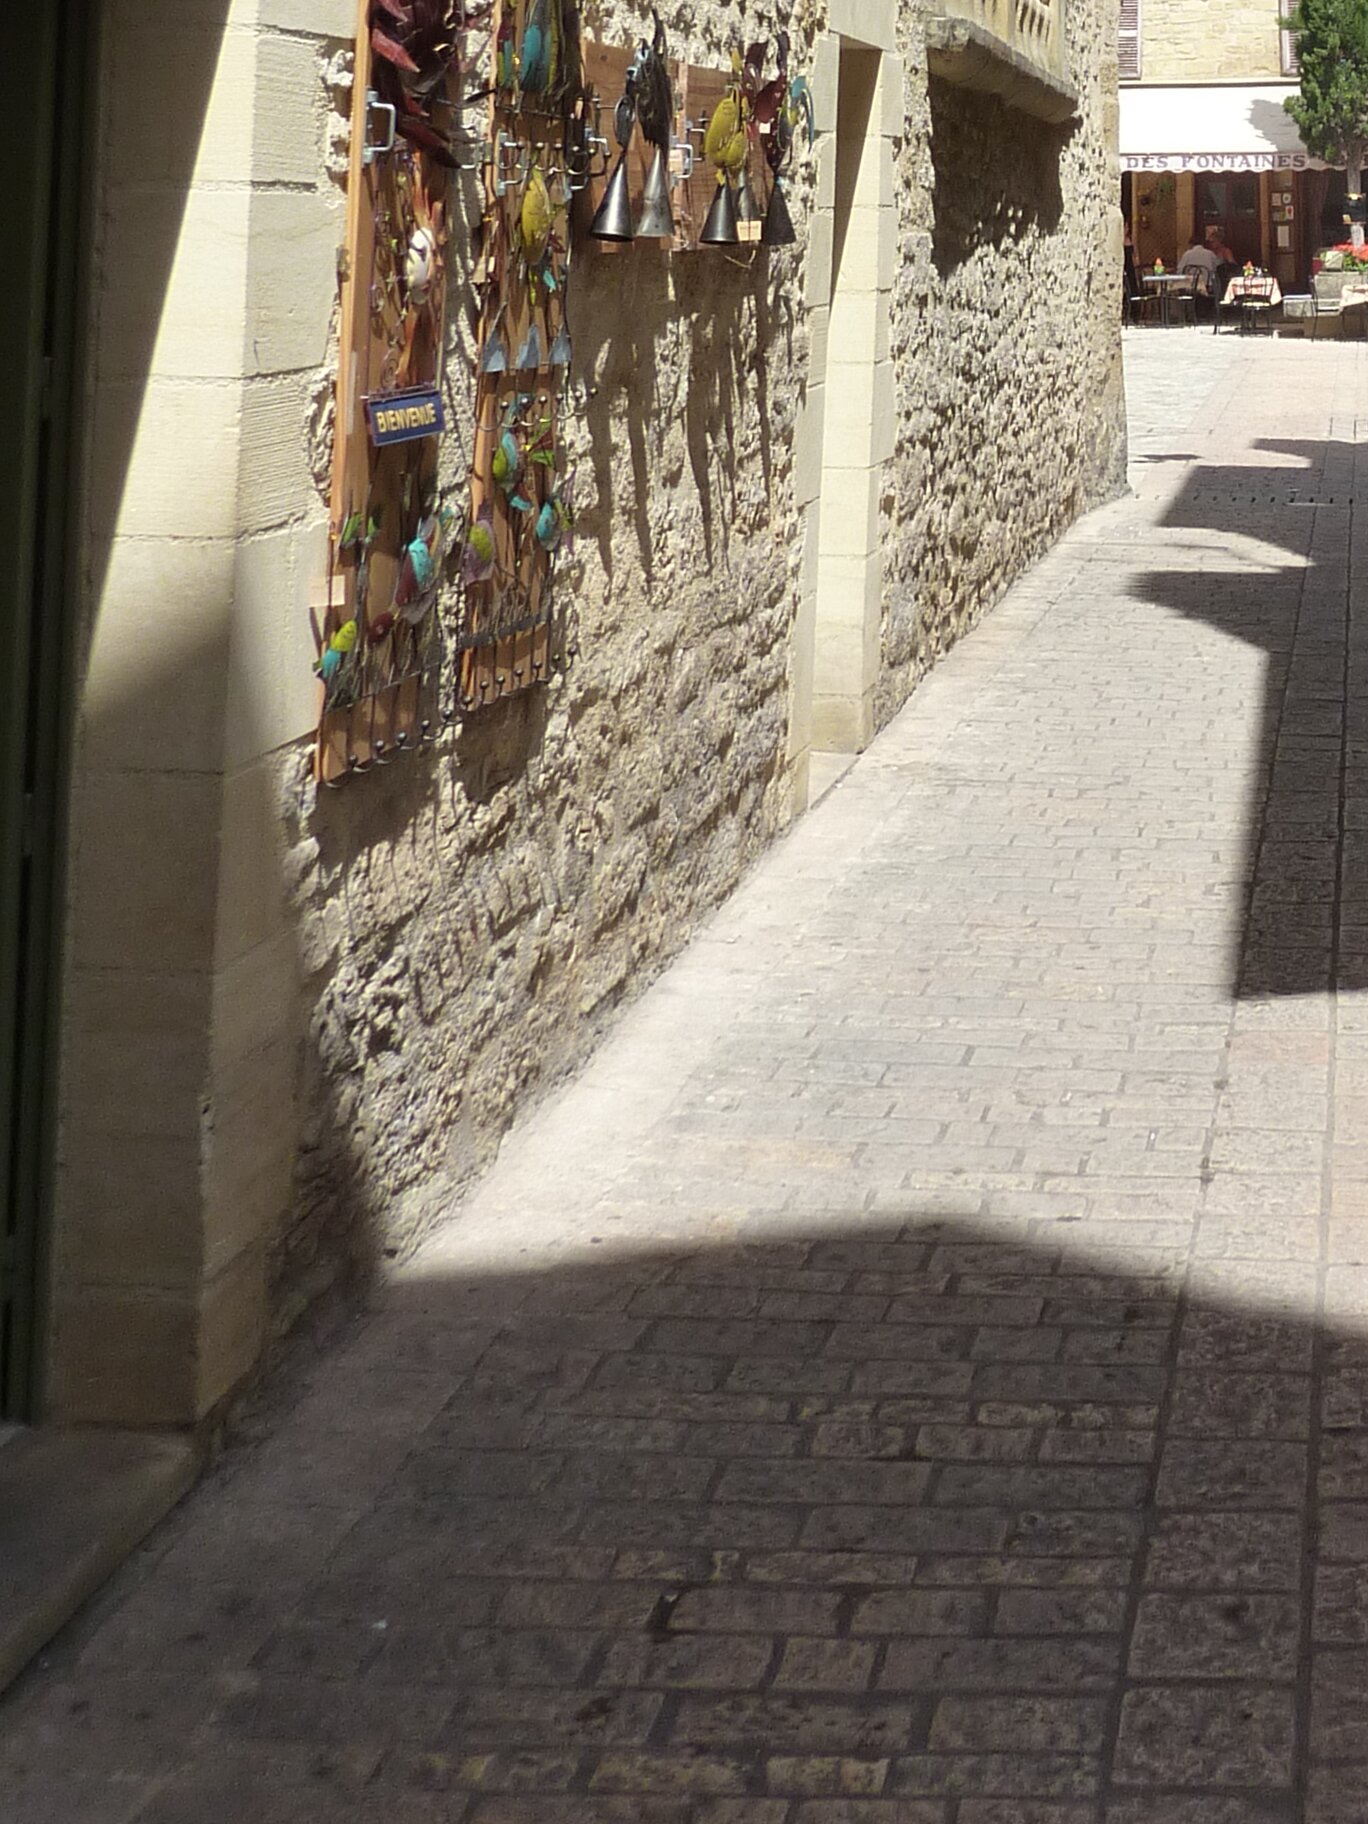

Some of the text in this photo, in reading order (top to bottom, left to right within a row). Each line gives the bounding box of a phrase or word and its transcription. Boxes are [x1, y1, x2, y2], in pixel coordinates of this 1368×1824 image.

[1126, 155, 1169, 169] DES
[1181, 153, 1306, 169] FONTAINES
[375, 402, 437, 433] BIENVENUE
